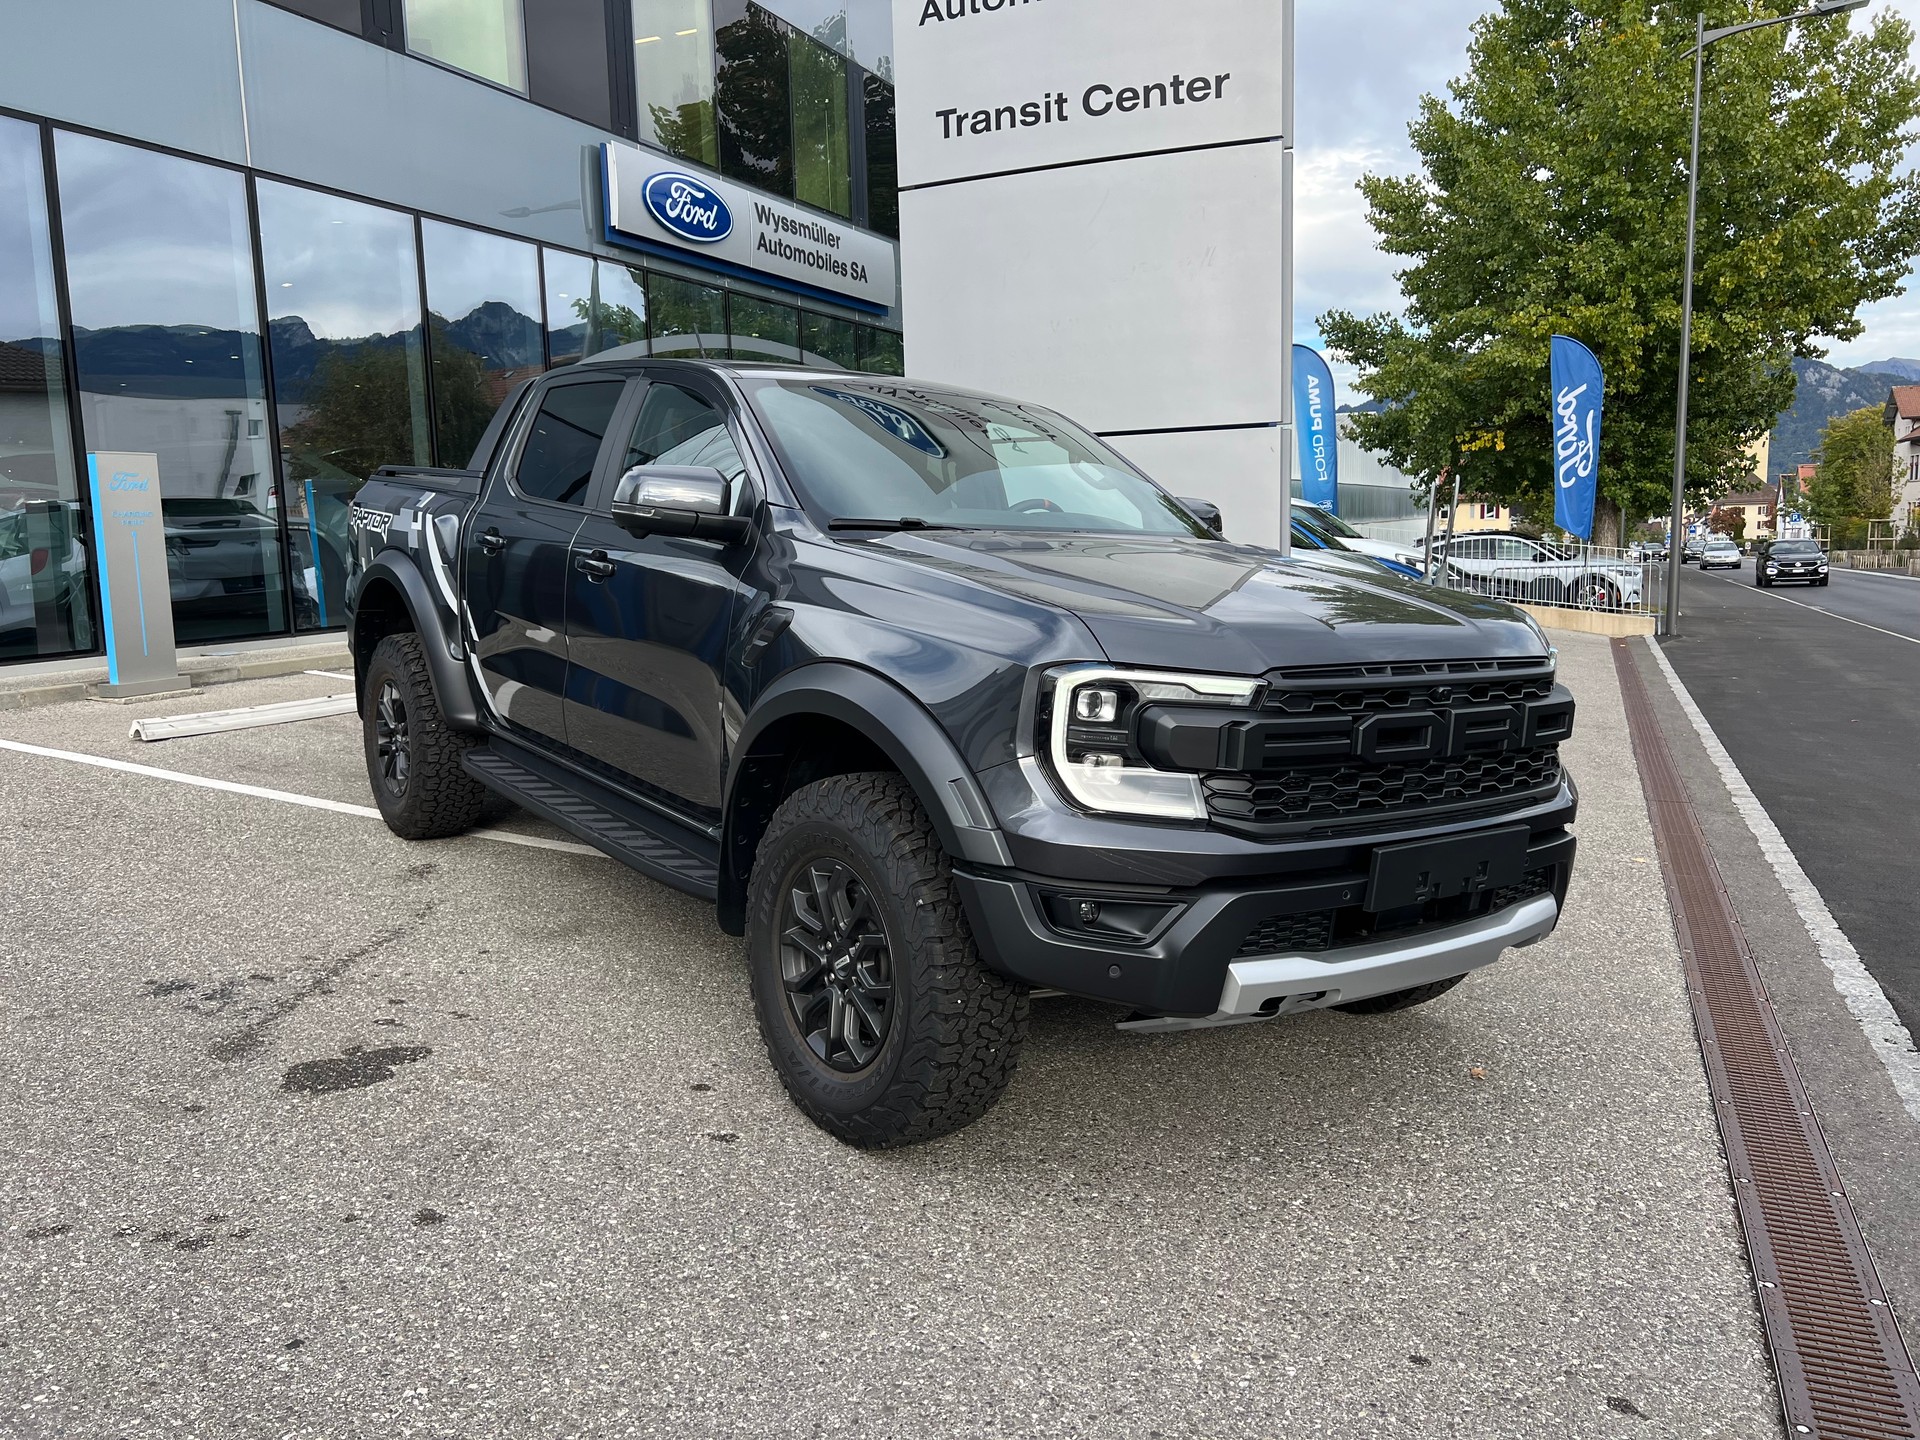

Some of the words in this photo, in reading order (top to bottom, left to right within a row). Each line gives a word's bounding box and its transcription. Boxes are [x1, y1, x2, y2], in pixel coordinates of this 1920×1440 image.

[936, 91, 1069, 140] Transit
[1082, 72, 1231, 118] Center
[666, 182, 717, 230] Ford
[754, 202, 841, 250] Wyssmüller
[757, 231, 848, 277] Automobiles
[849, 261, 868, 283] SA
[109, 472, 148, 491] Ford
[350, 506, 393, 544] RAPTOR
[1240, 697, 1576, 772] FORD
